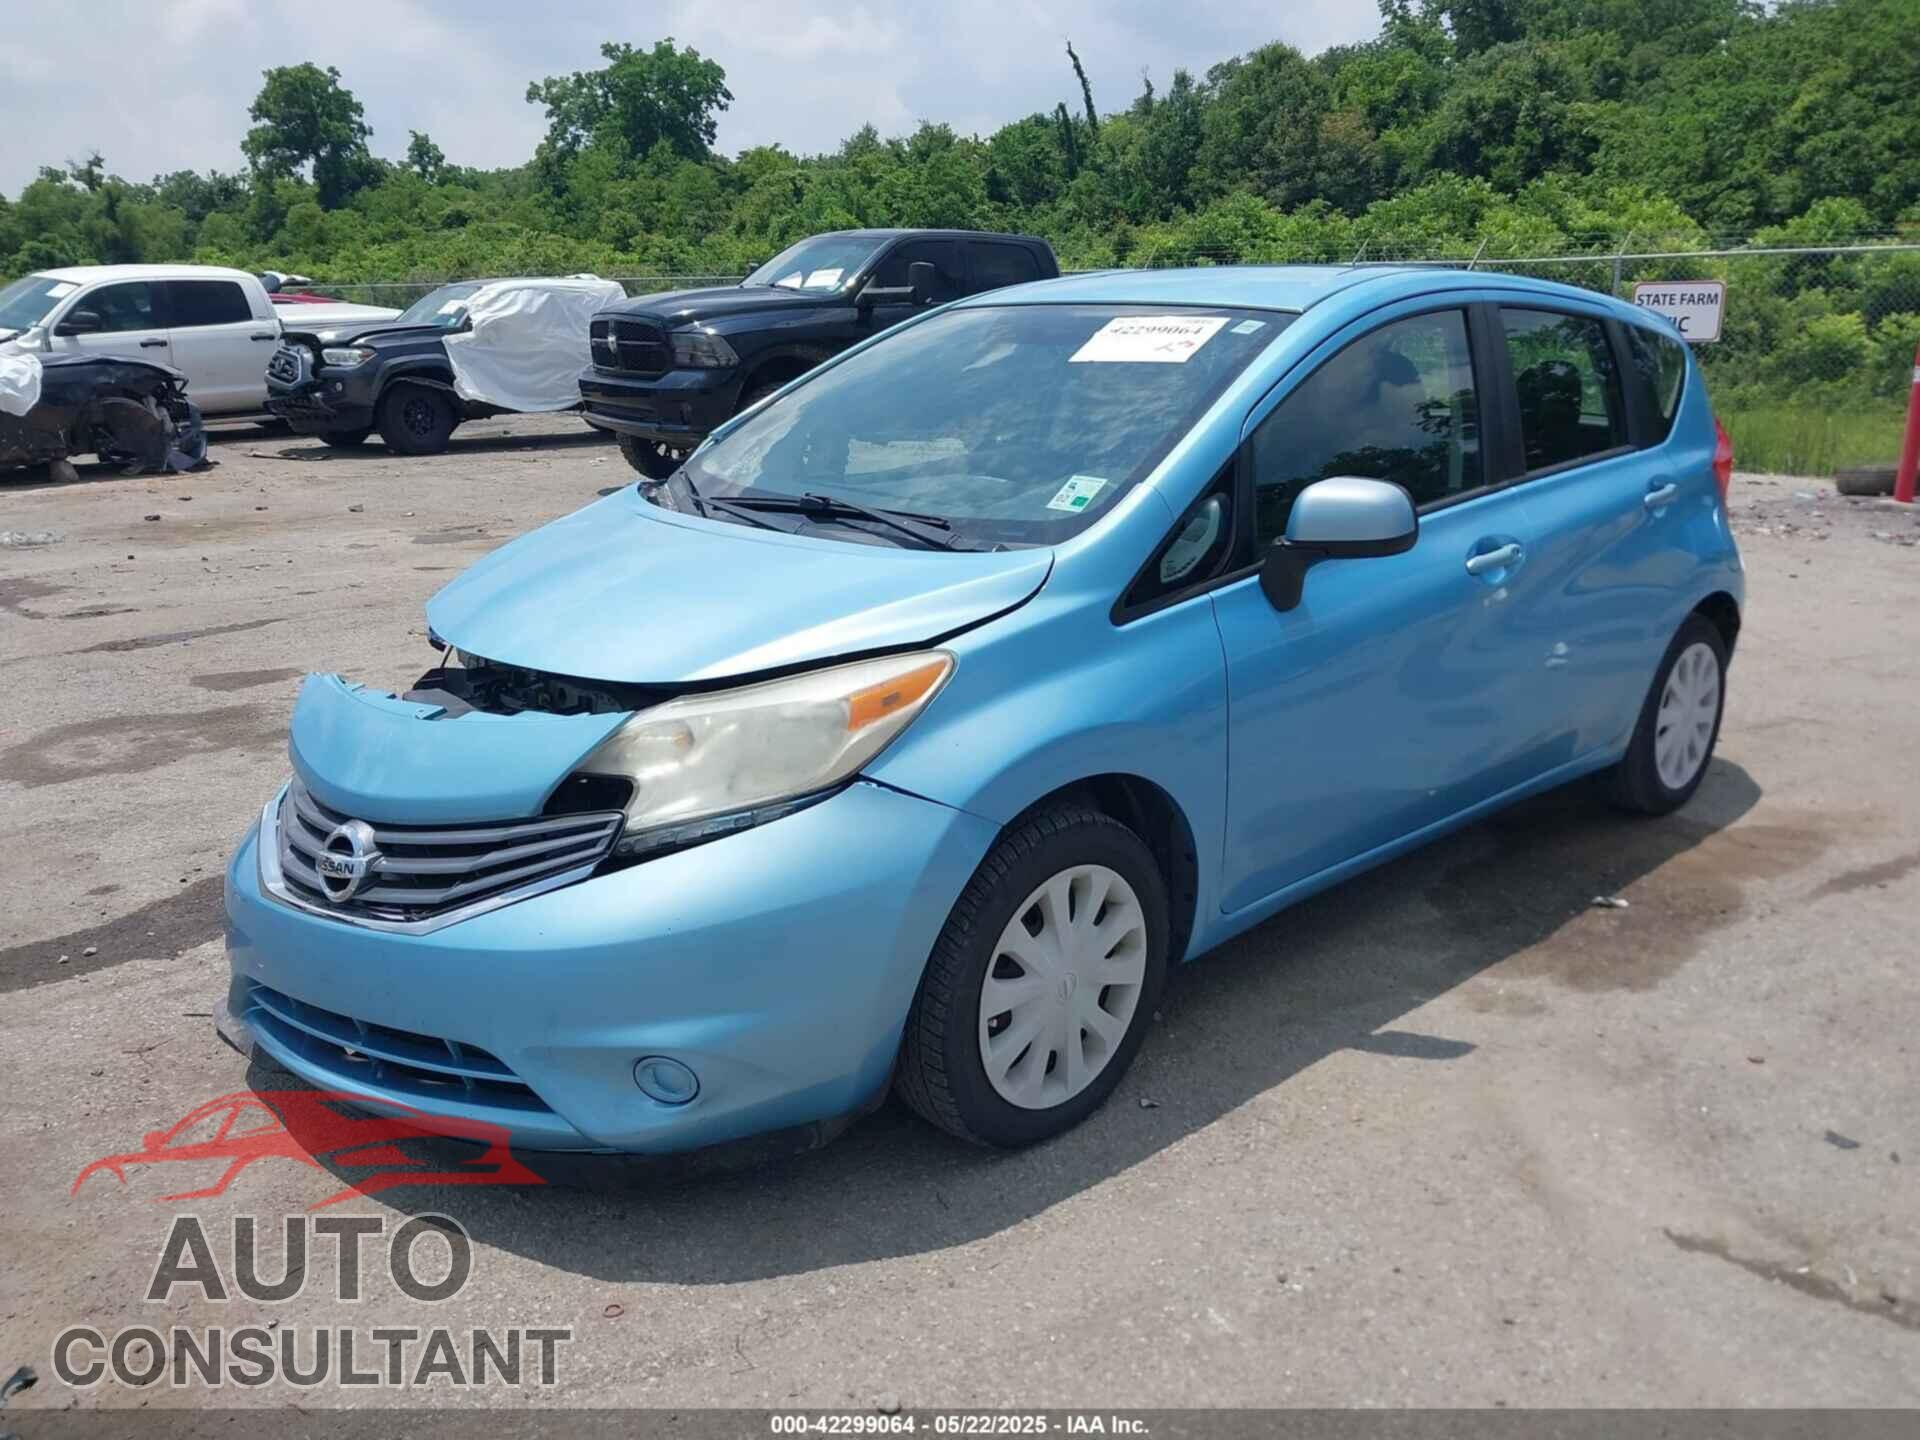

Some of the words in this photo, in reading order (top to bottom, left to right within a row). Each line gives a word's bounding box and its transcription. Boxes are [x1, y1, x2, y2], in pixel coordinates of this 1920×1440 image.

[1636, 293, 1676, 306] STATE
[1679, 292, 1719, 305] FARM
[1667, 315, 1691, 333] IC
